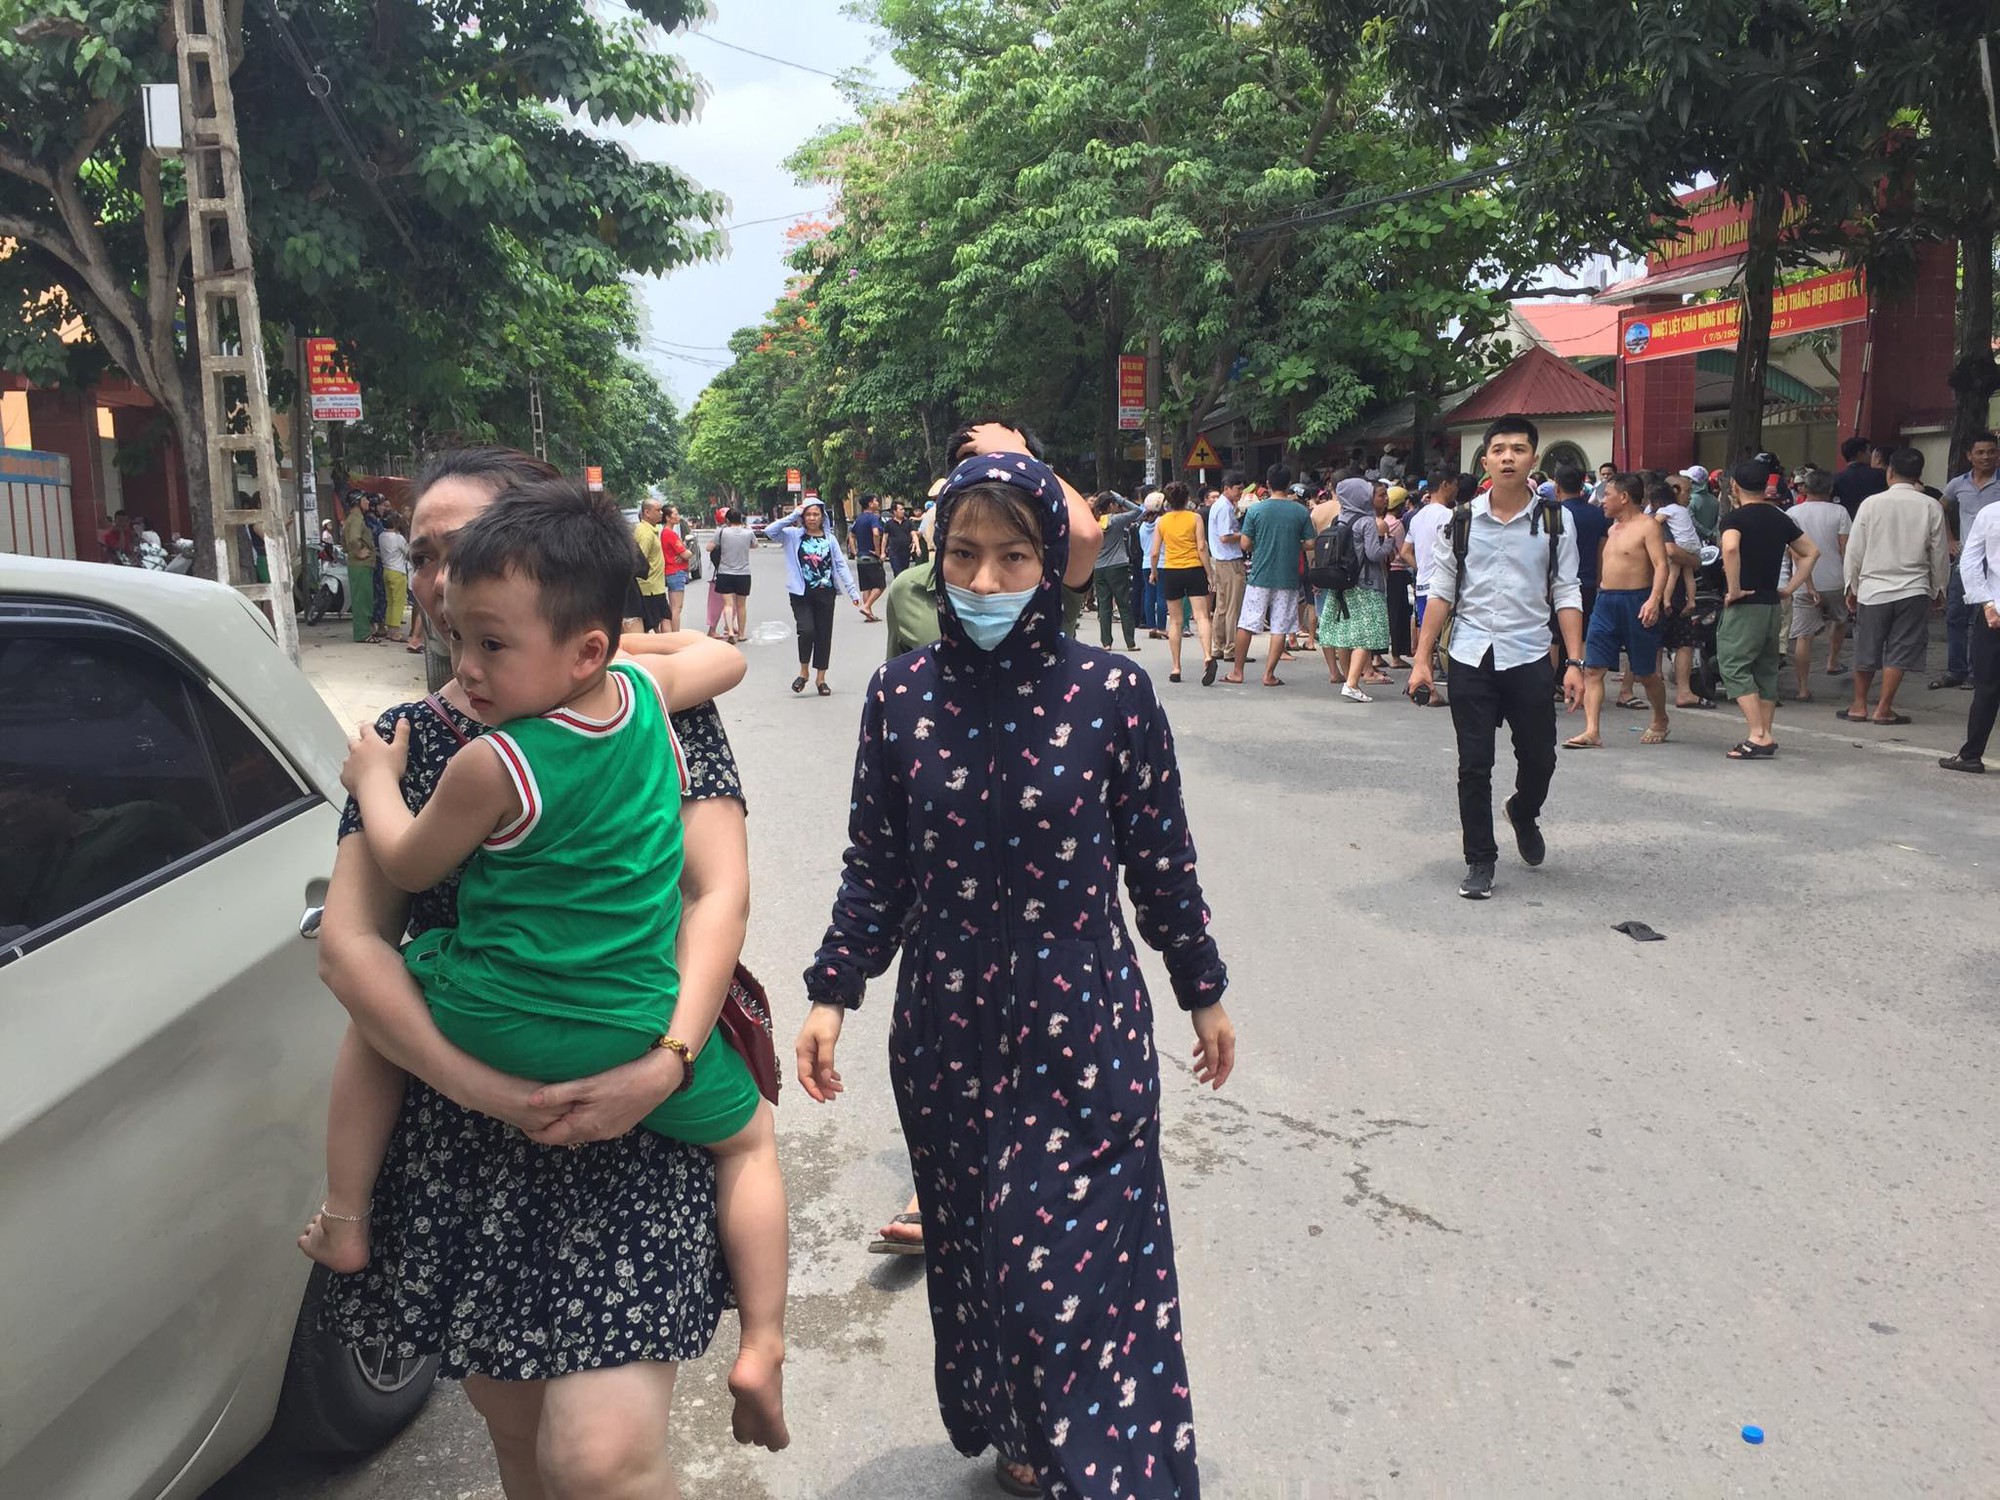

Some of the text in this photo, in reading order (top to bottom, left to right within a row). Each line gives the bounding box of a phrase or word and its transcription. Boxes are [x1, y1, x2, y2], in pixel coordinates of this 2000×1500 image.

[1695, 228, 1715, 252] HUY
[1719, 217, 1749, 247] QUÂN
[1829, 279, 1846, 303] BIÊN
